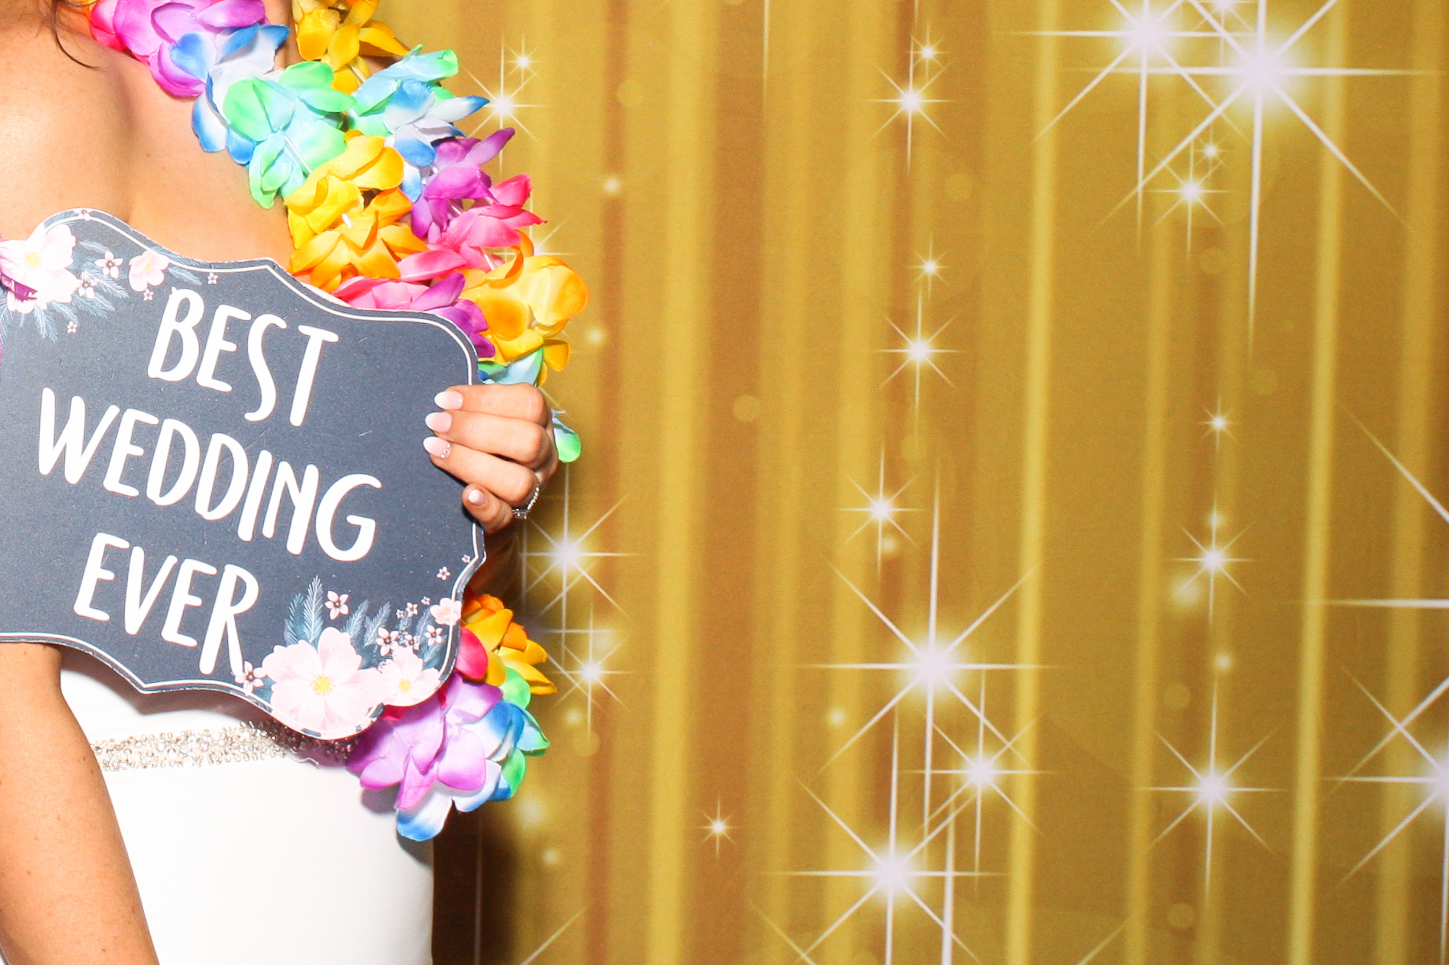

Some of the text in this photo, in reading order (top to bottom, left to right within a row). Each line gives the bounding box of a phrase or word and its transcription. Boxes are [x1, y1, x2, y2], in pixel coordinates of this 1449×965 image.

[147, 288, 339, 427] BEST
[38, 387, 383, 562] WEDDING
[73, 533, 259, 679] EVER
